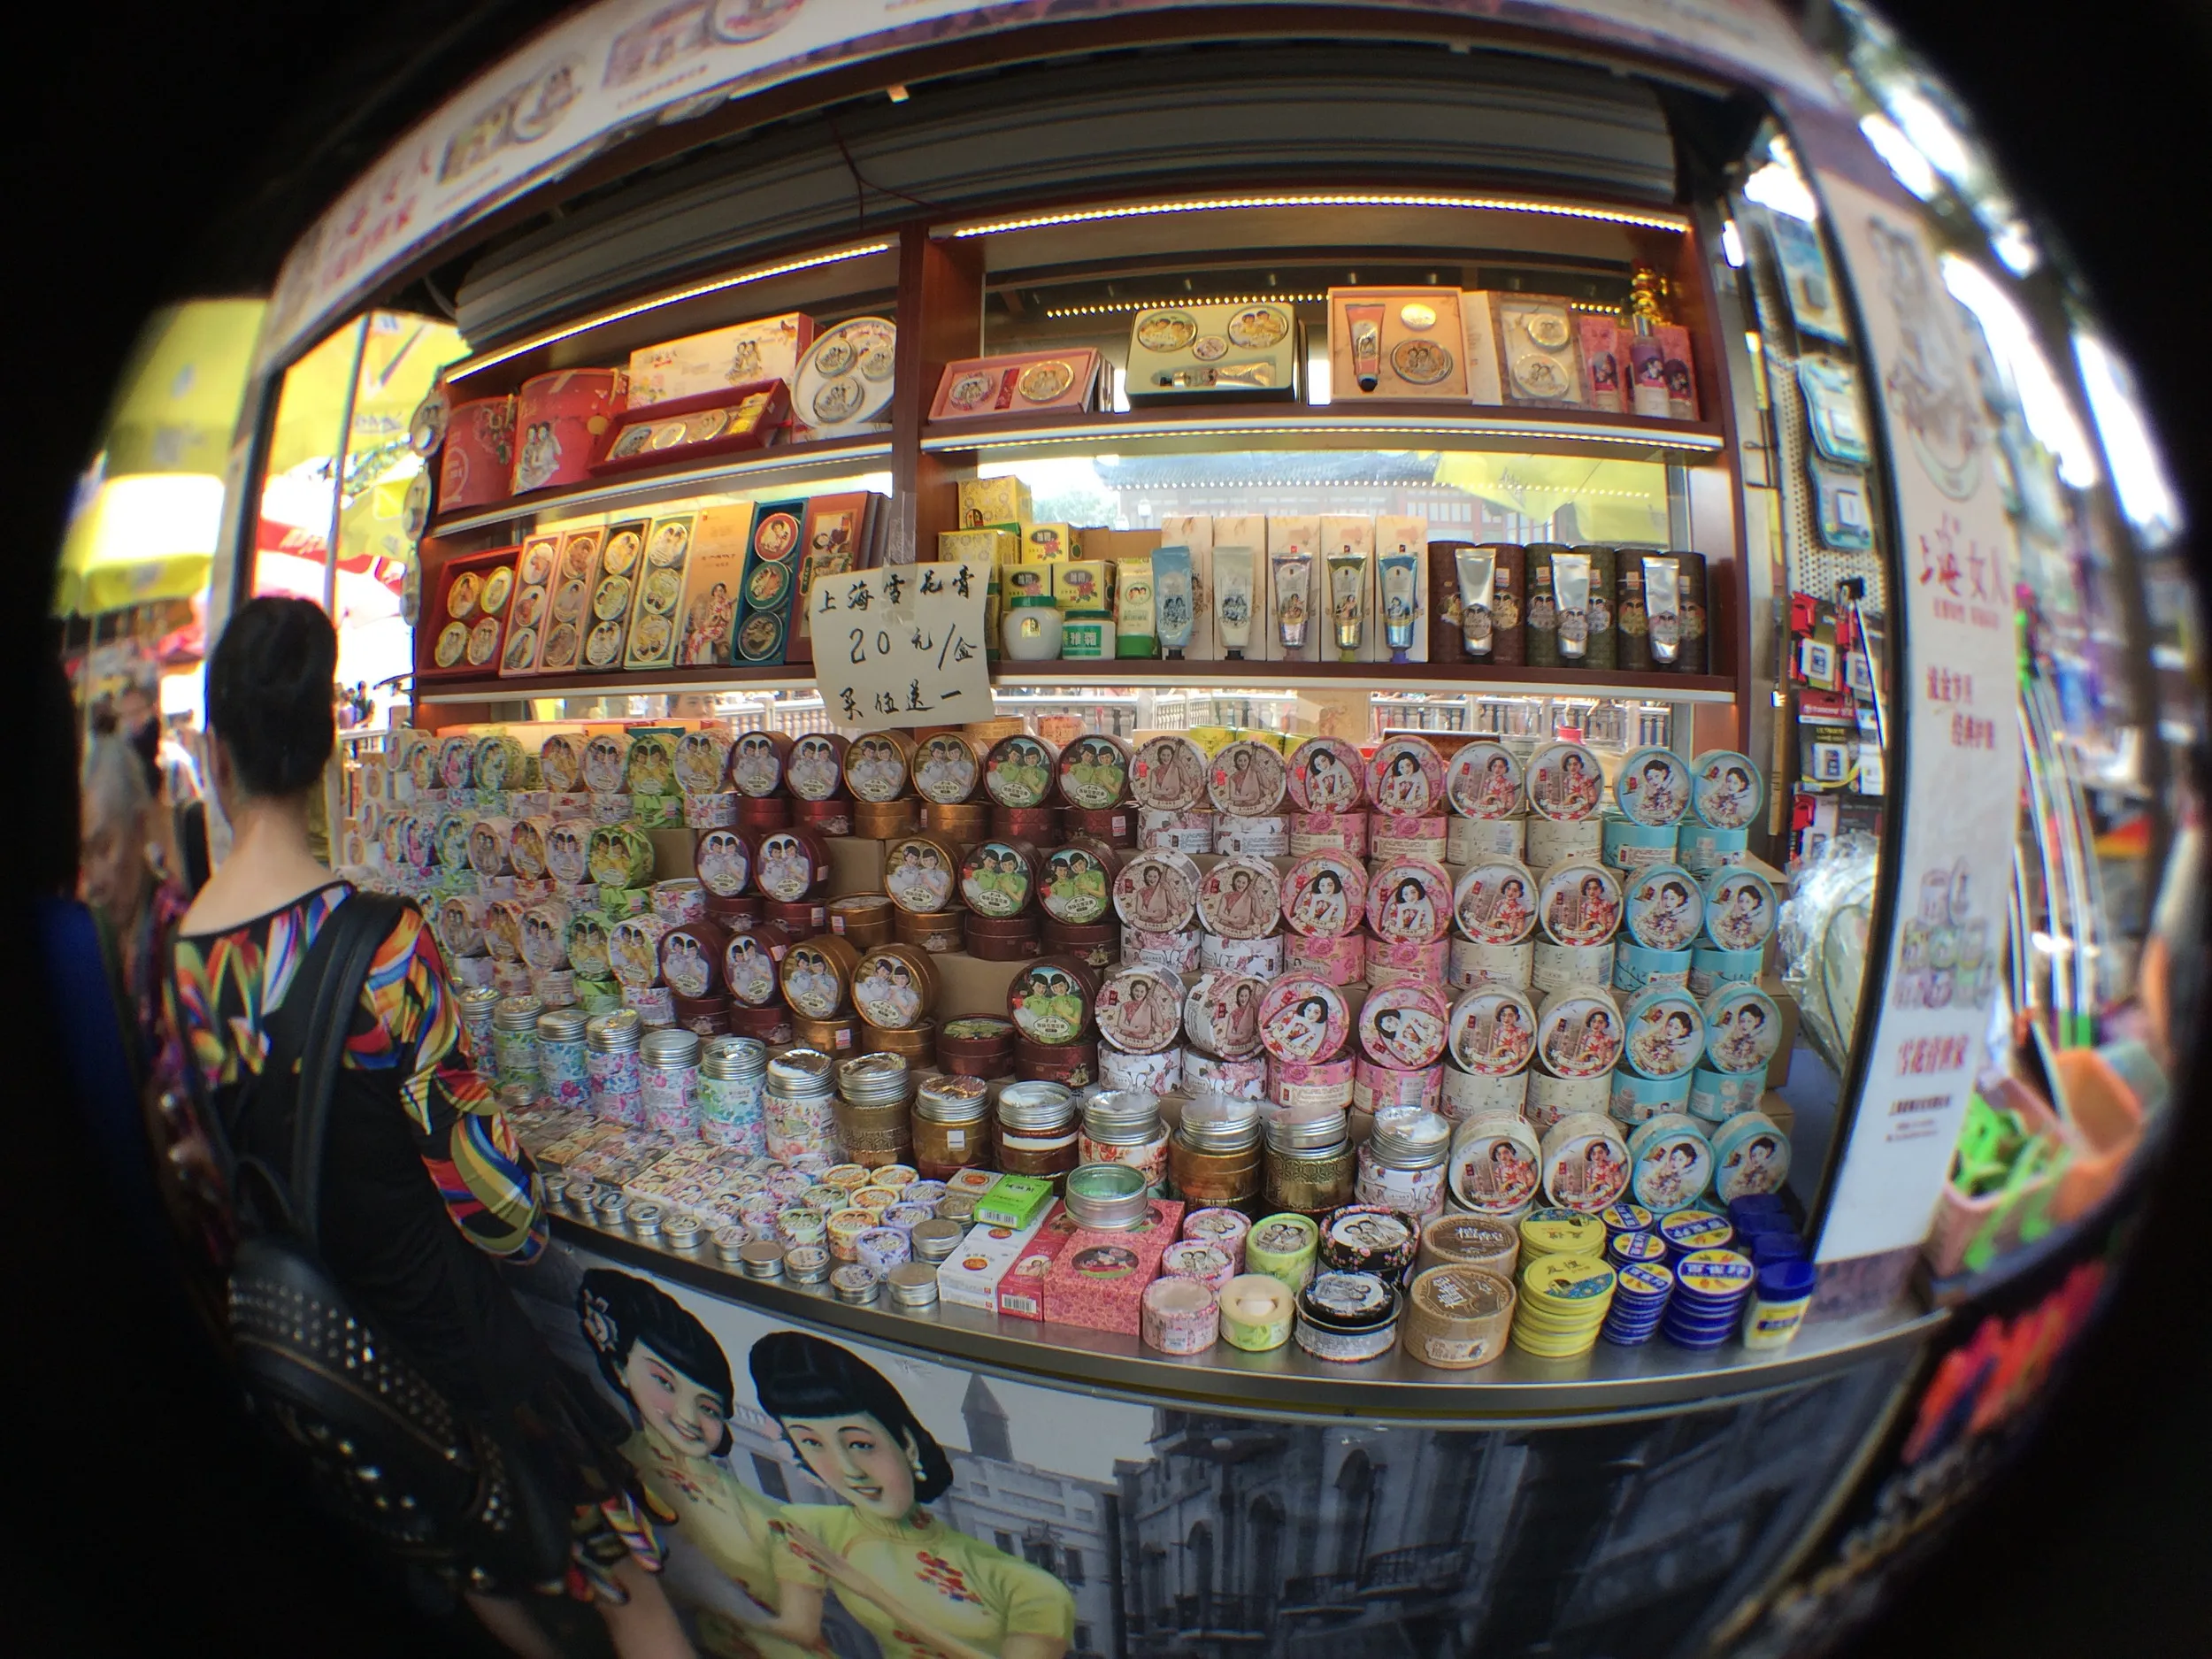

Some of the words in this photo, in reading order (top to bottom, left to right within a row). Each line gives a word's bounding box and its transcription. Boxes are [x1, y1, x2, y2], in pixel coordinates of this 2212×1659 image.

[818, 565, 974, 613] 上海雪花膏
[839, 679, 963, 721] 买伍送一
